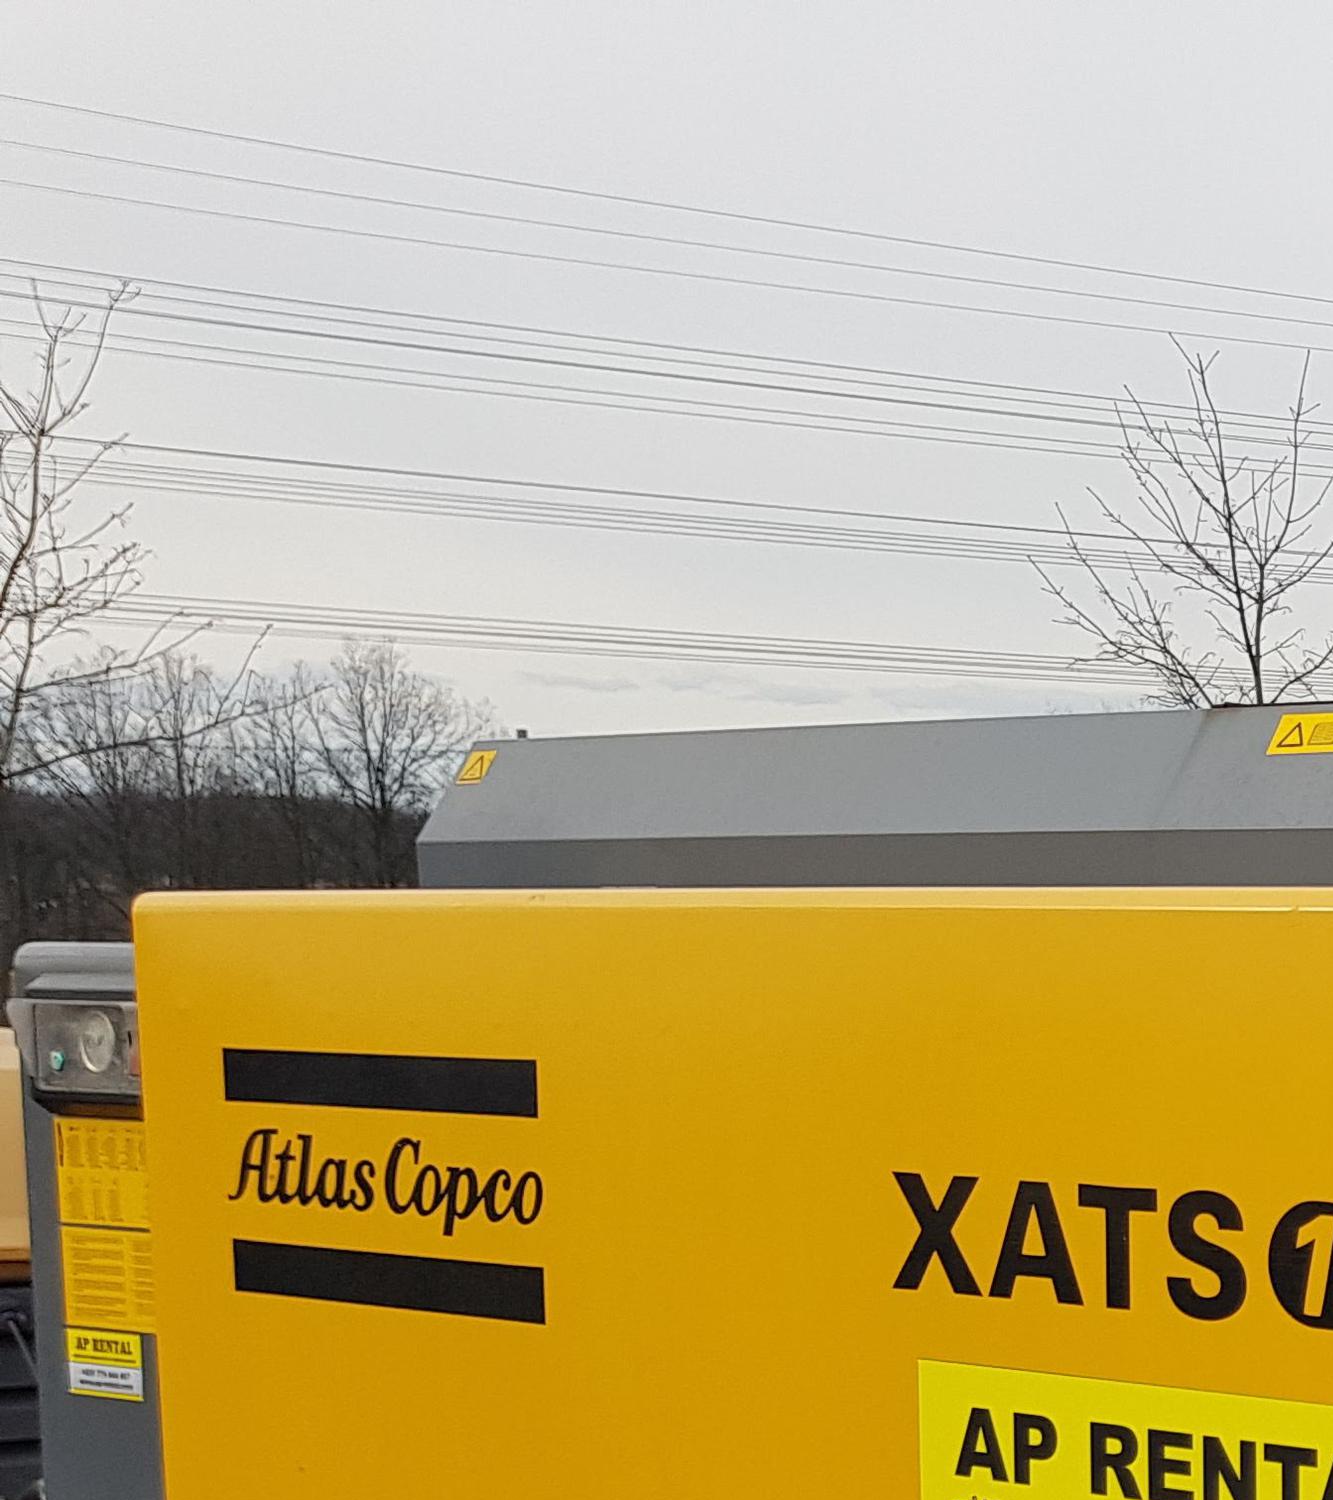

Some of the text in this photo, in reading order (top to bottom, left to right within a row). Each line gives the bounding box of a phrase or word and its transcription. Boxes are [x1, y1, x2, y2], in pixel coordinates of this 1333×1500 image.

[229, 1129, 375, 1211] Atlas
[386, 1138, 542, 1236] Copco
[892, 1171, 1247, 1321] XATS
[955, 1407, 1057, 1485] AP
